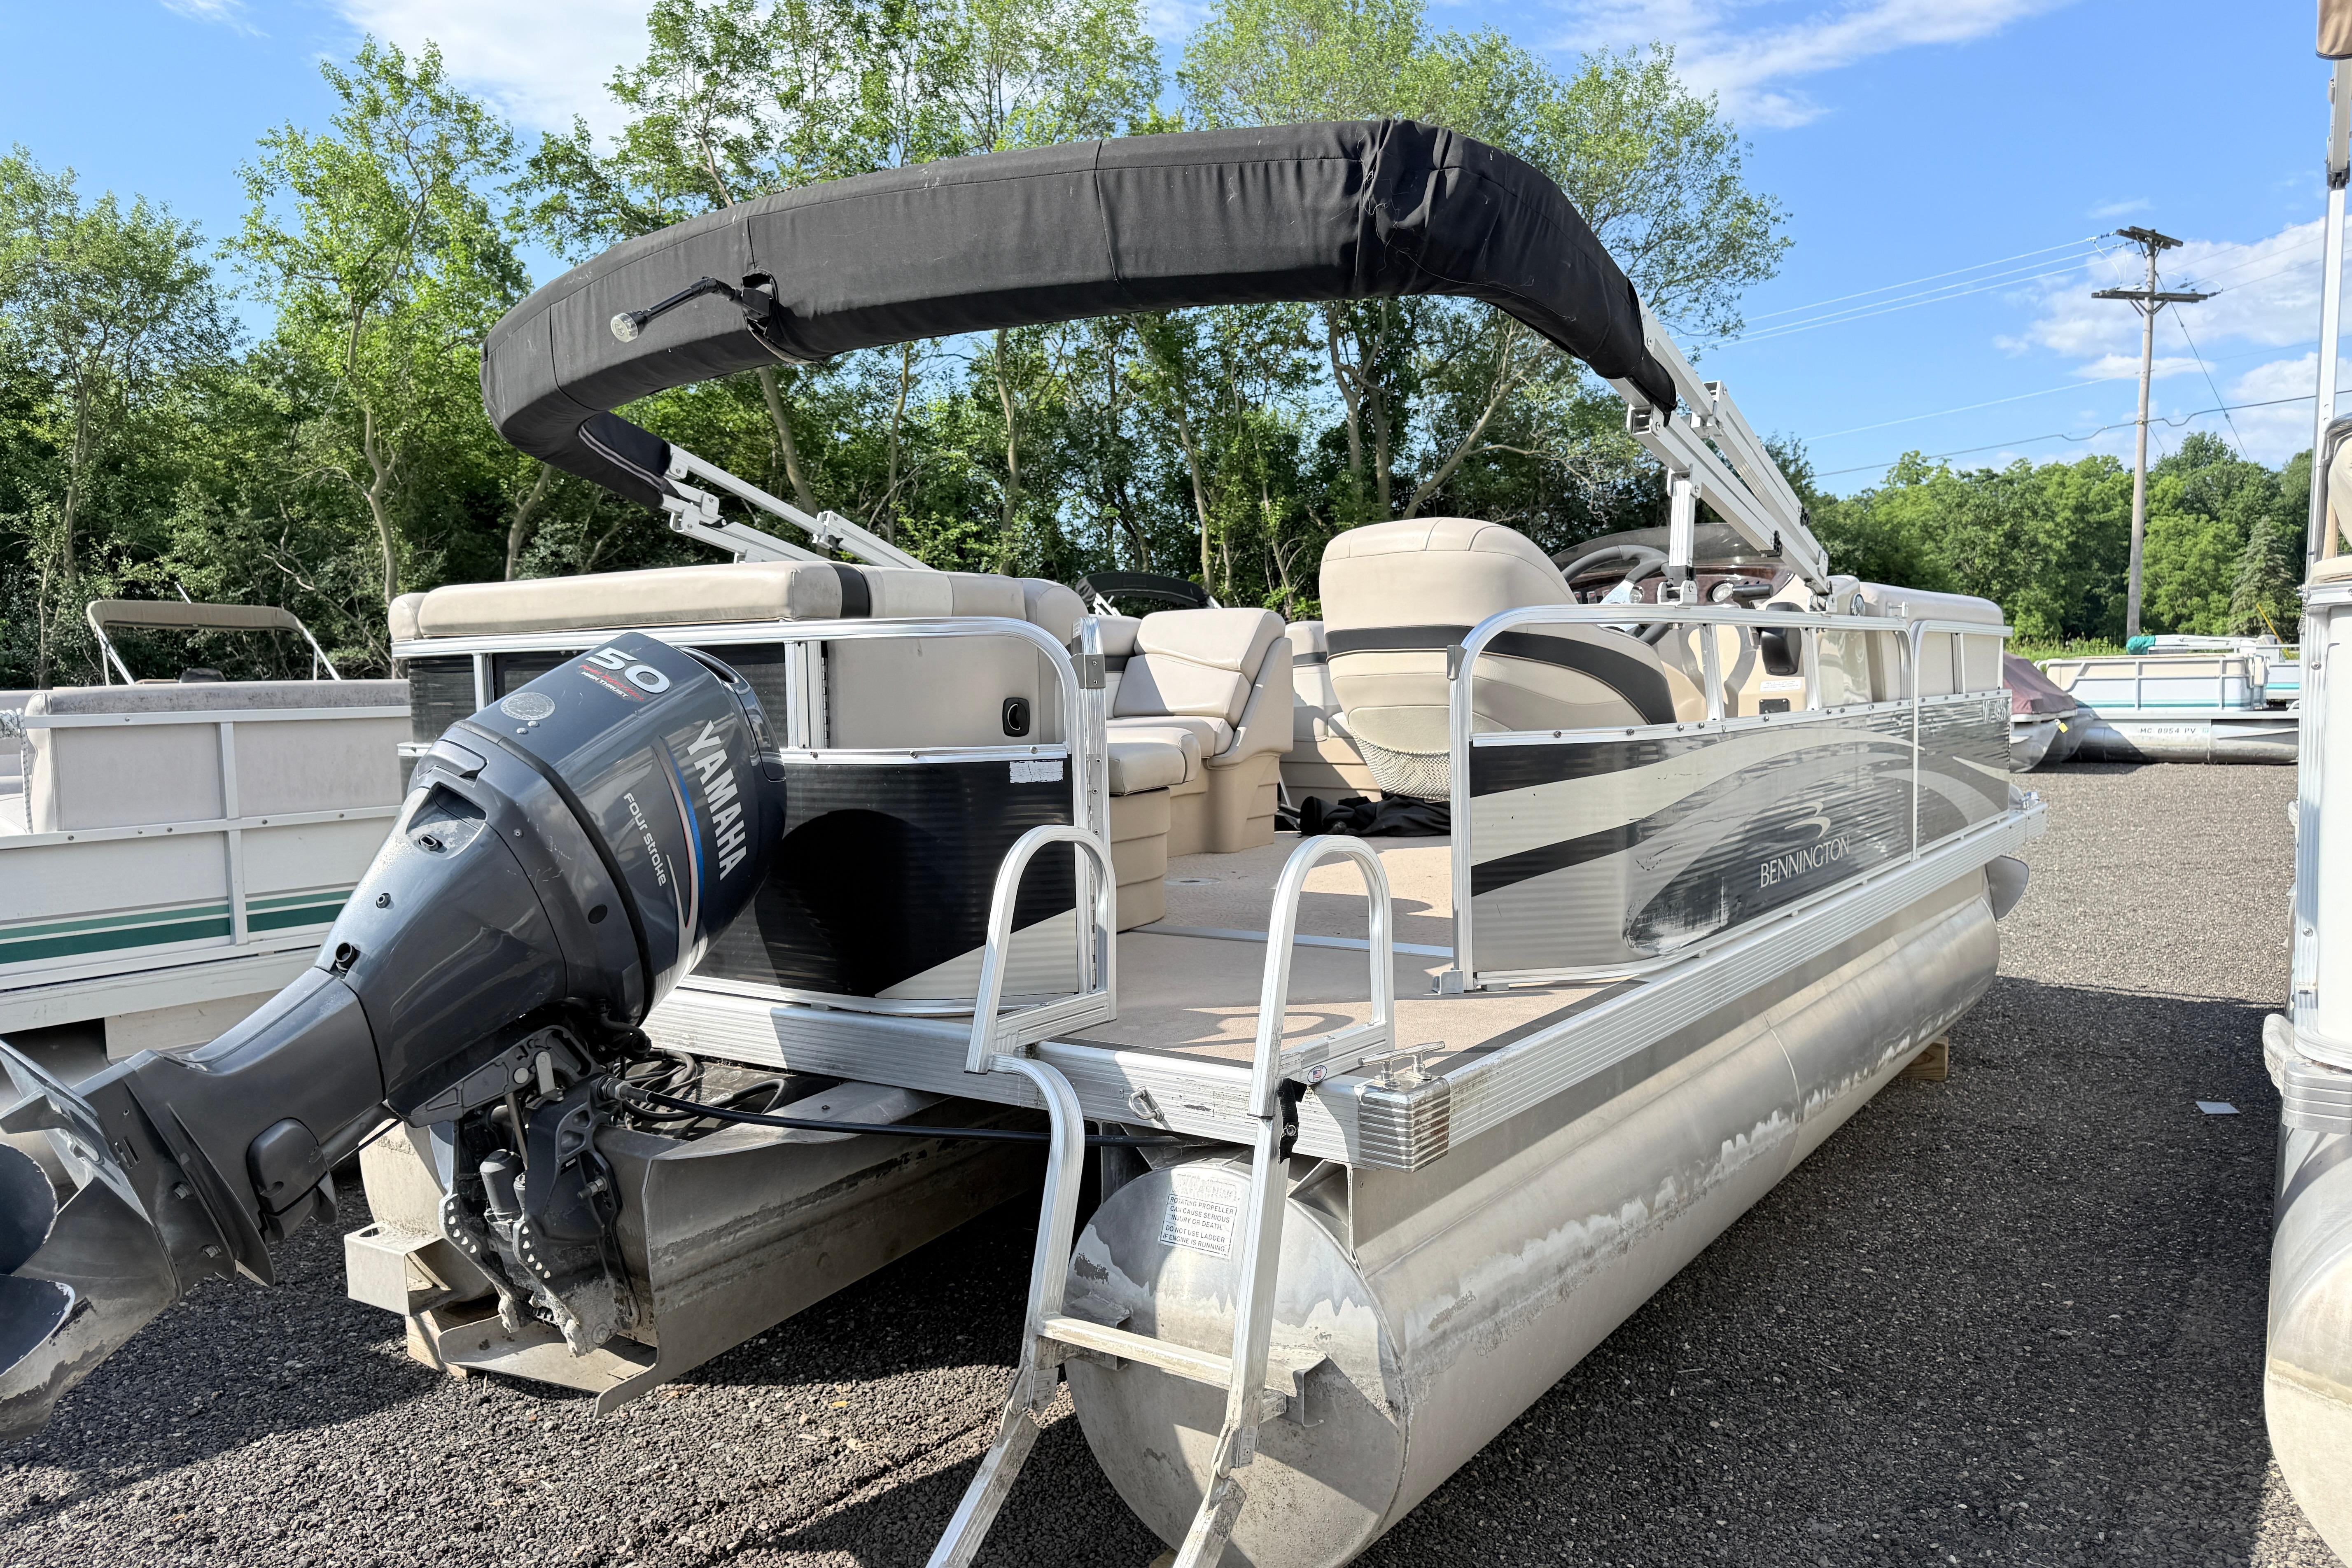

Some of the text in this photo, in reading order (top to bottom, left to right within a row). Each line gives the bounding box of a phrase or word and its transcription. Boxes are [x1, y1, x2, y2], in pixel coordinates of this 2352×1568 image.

[585, 647, 670, 693] 50
[581, 671, 629, 697] HIGH THRUST
[687, 720, 747, 881] YAMAHA
[1760, 834, 1849, 888] BENNINGTON
[1170, 1197, 1234, 1215] ROTATING PROPELLER
[1171, 1214, 1191, 1224] INJURY
[1202, 1221, 1223, 1231] DEATH.
[1183, 1208, 1202, 1217] CAUSE
[1203, 1212, 1230, 1223] SERIOUS
[1169, 1234, 1190, 1244] ENGINE
[1197, 1241, 1226, 1252] RUNNING.
[1201, 1232, 1225, 1243] LADDER
